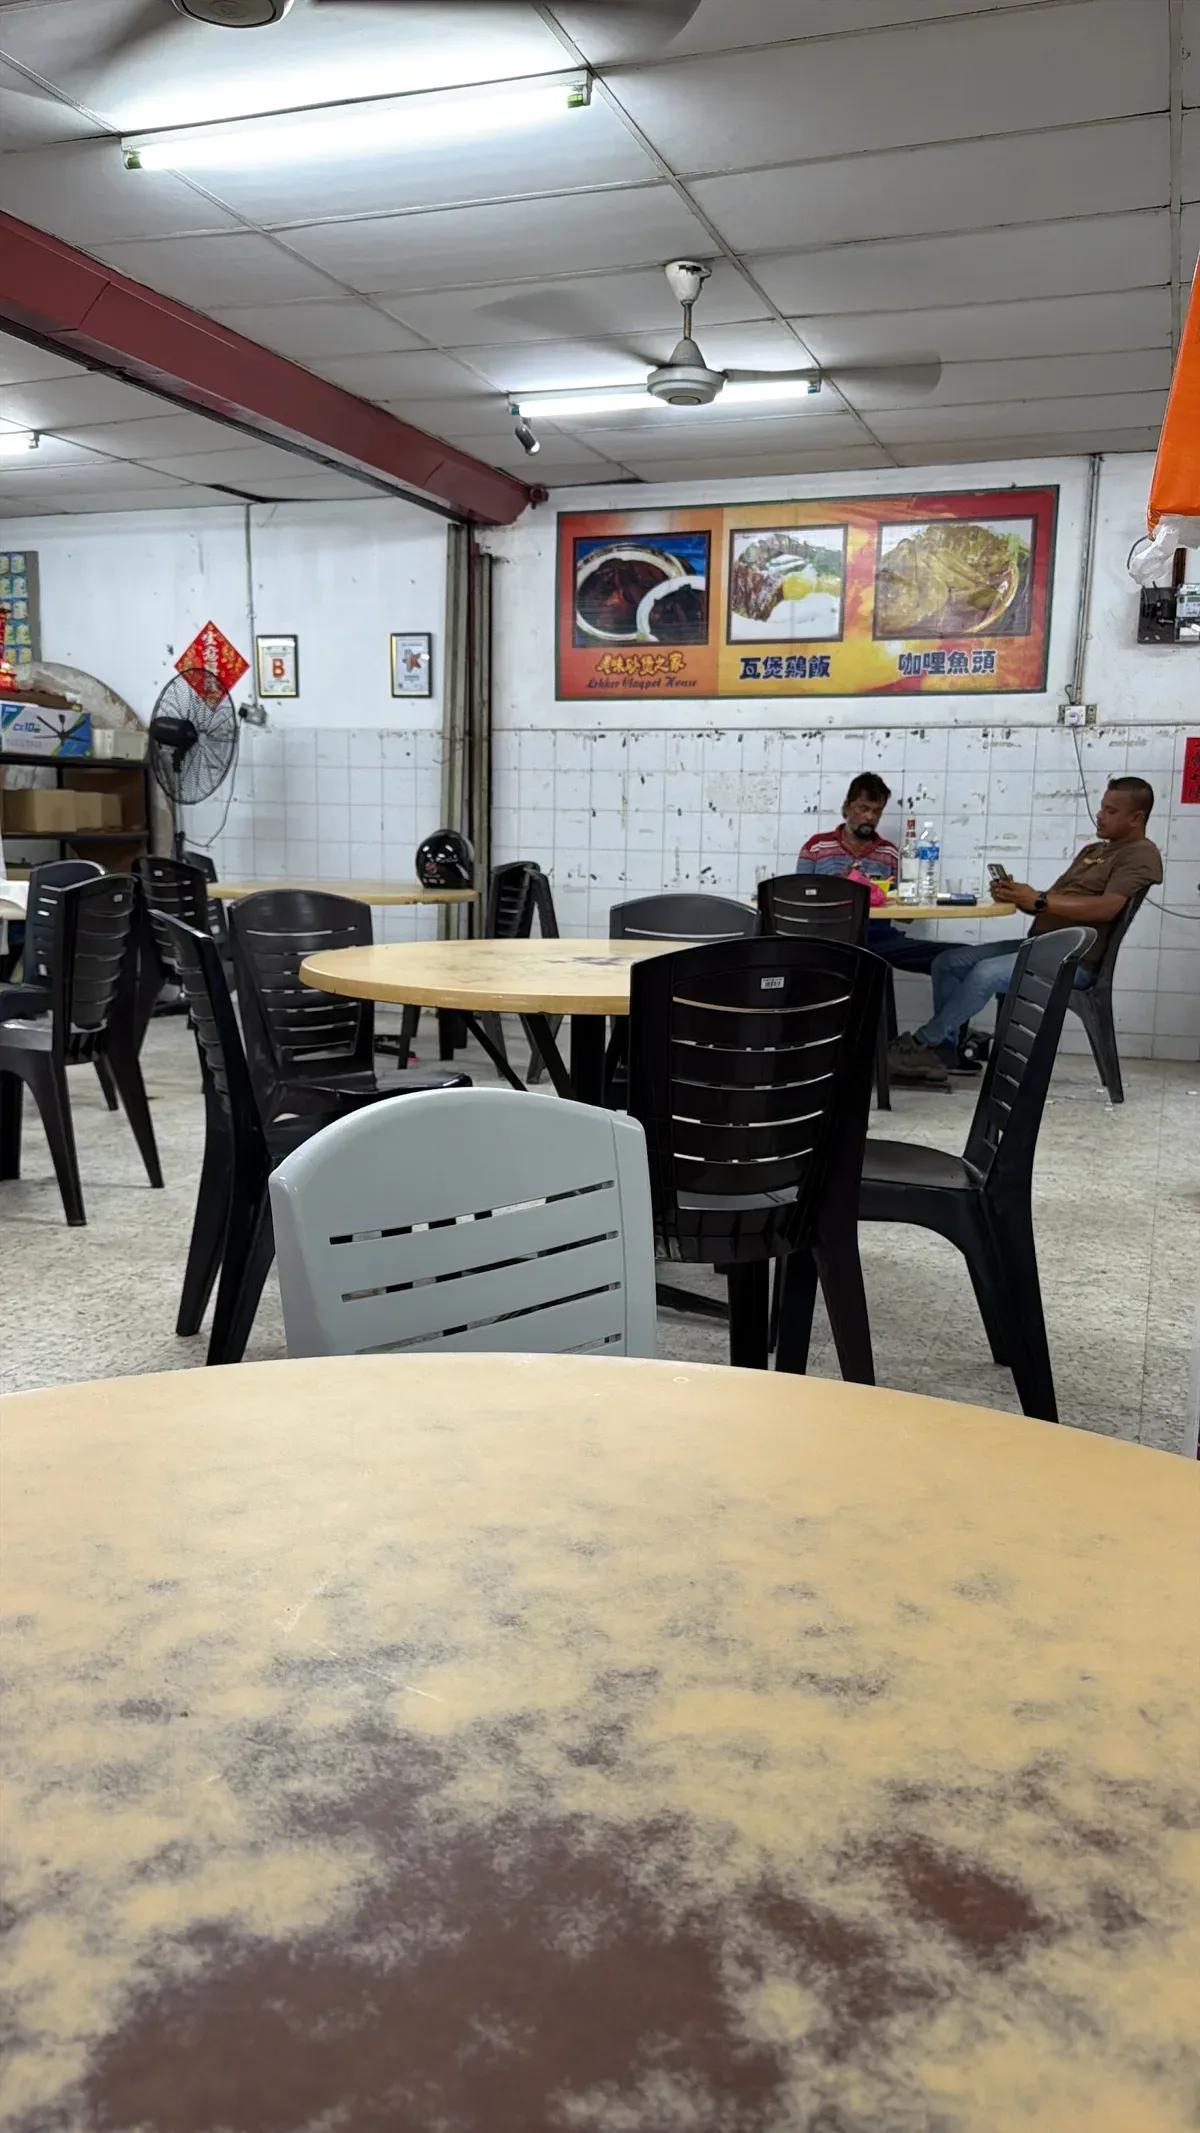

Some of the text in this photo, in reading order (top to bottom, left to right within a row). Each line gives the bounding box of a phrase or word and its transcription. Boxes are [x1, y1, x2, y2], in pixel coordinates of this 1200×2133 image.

[272, 658, 285, 678] B
[898, 650, 996, 675] 咖哩魚頭
